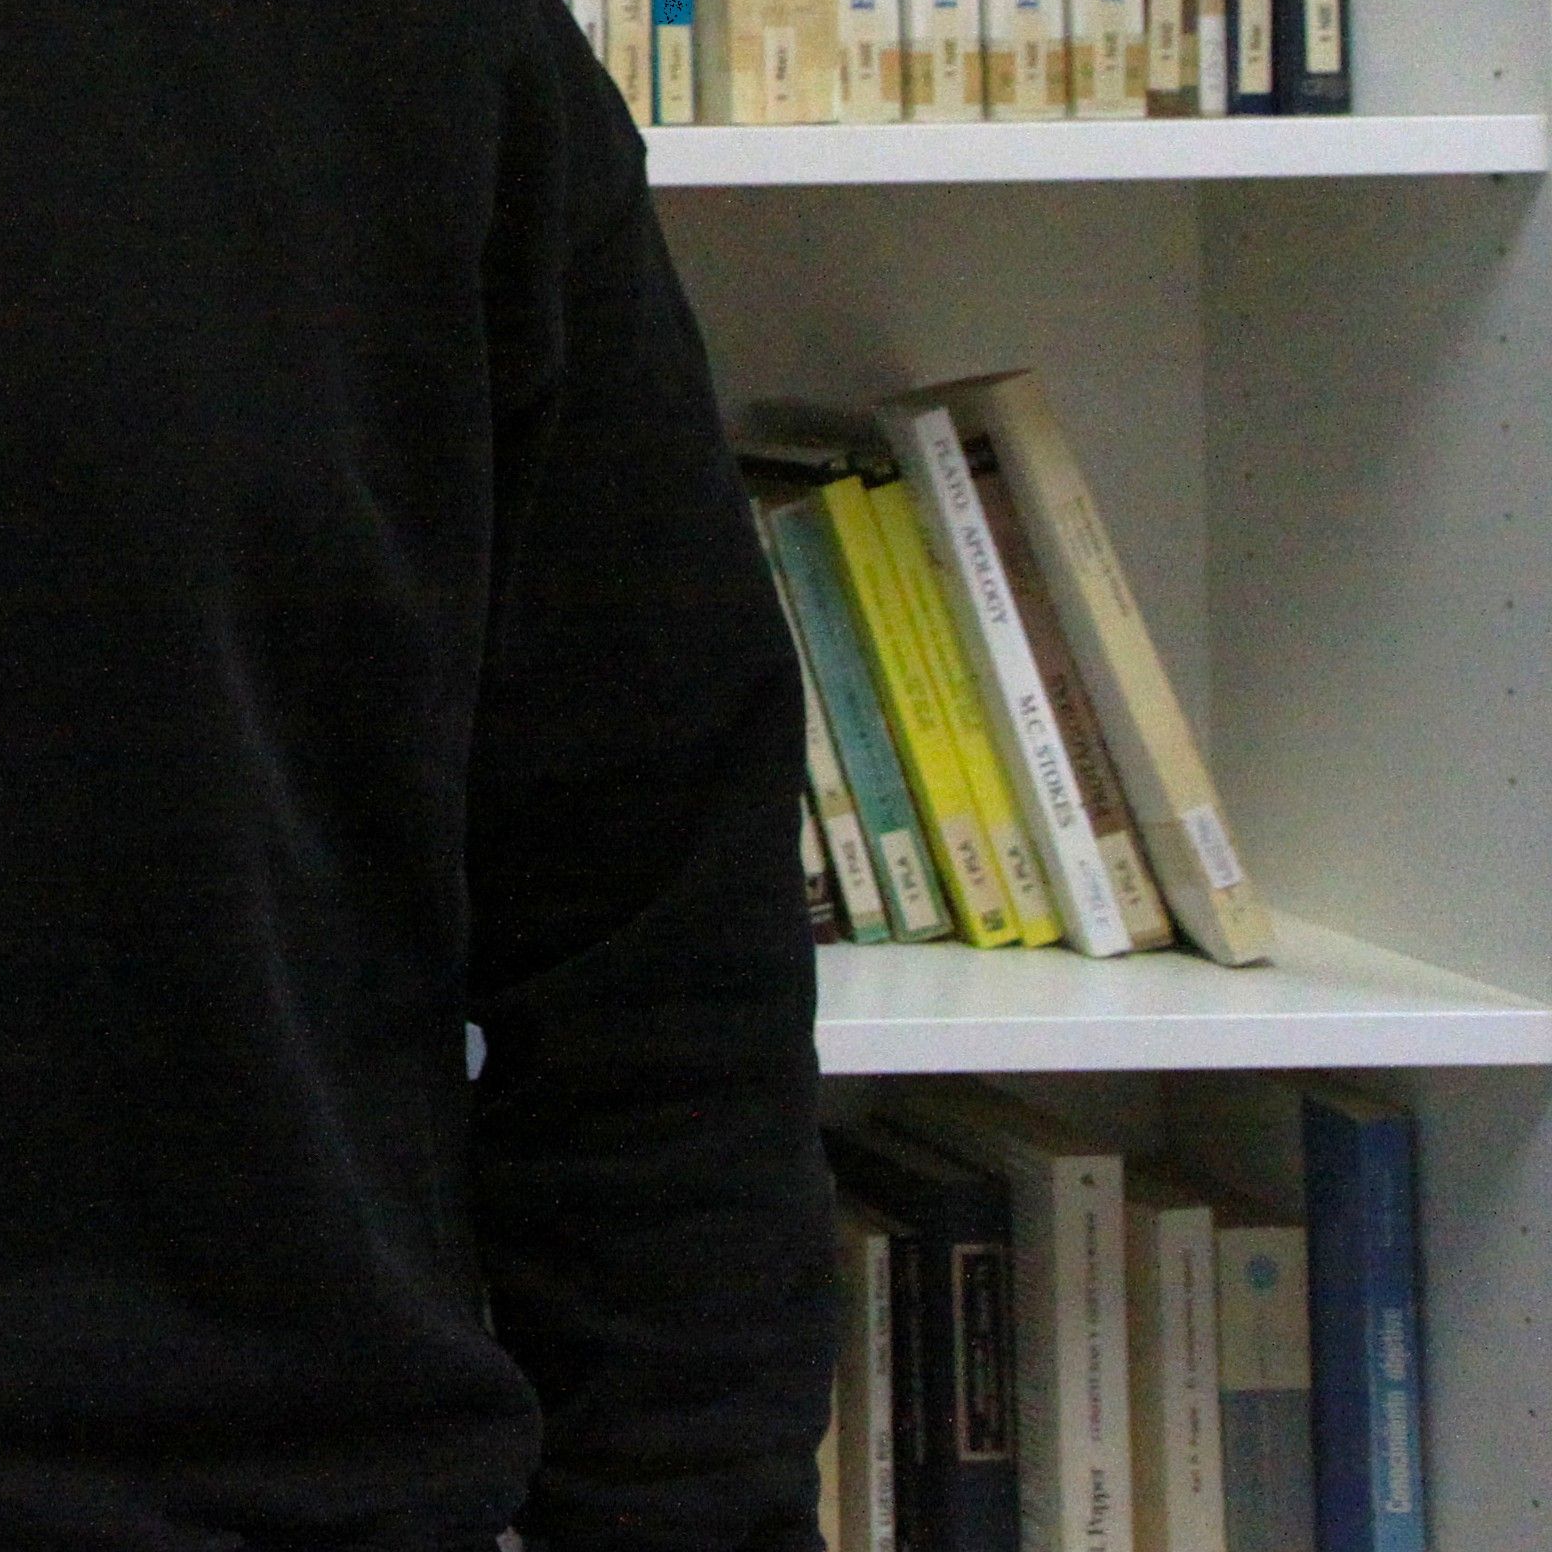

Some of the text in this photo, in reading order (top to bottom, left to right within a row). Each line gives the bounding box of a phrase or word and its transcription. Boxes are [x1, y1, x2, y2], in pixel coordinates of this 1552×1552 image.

[960, 523, 1008, 626] APOLOGY
[1035, 743, 1078, 829] STOKES
[1086, 1467, 1109, 1536] Popper
[1384, 1390, 1412, 1514] Conocimiento
